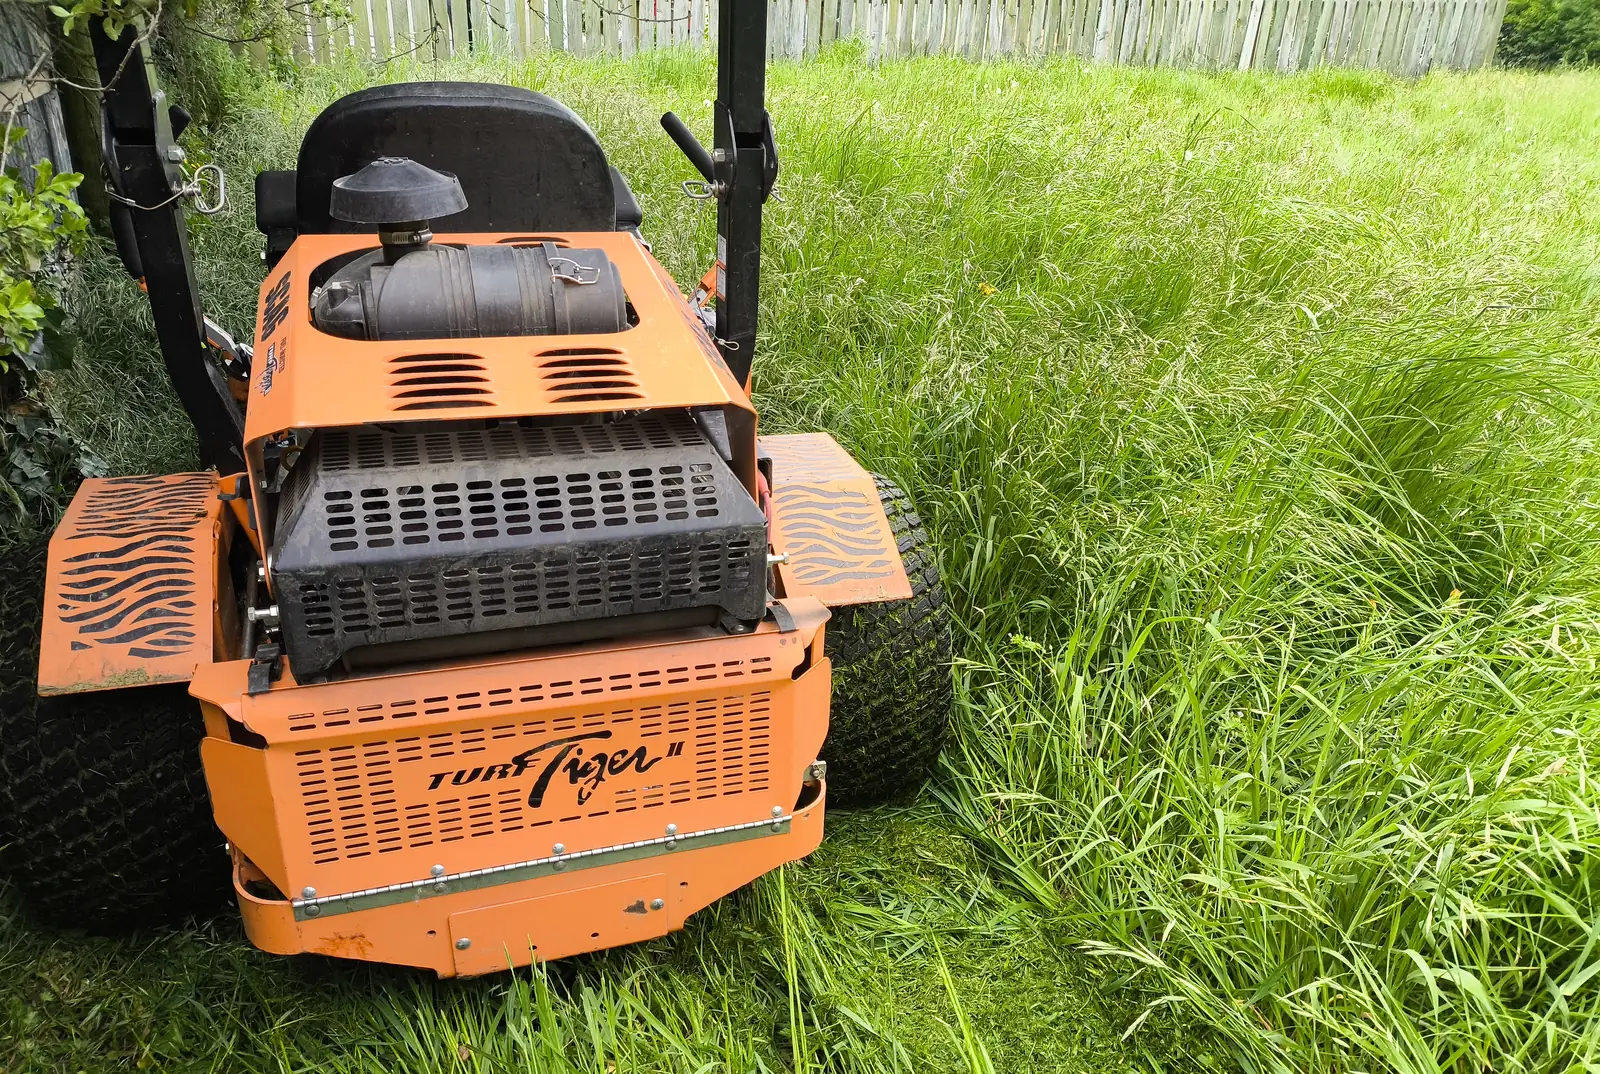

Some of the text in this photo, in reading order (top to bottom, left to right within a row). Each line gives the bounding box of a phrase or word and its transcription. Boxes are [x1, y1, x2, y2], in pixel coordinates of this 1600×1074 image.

[261, 271, 291, 342] SCAG
[427, 759, 541, 790] TURF
[513, 730, 662, 808] Tiger
